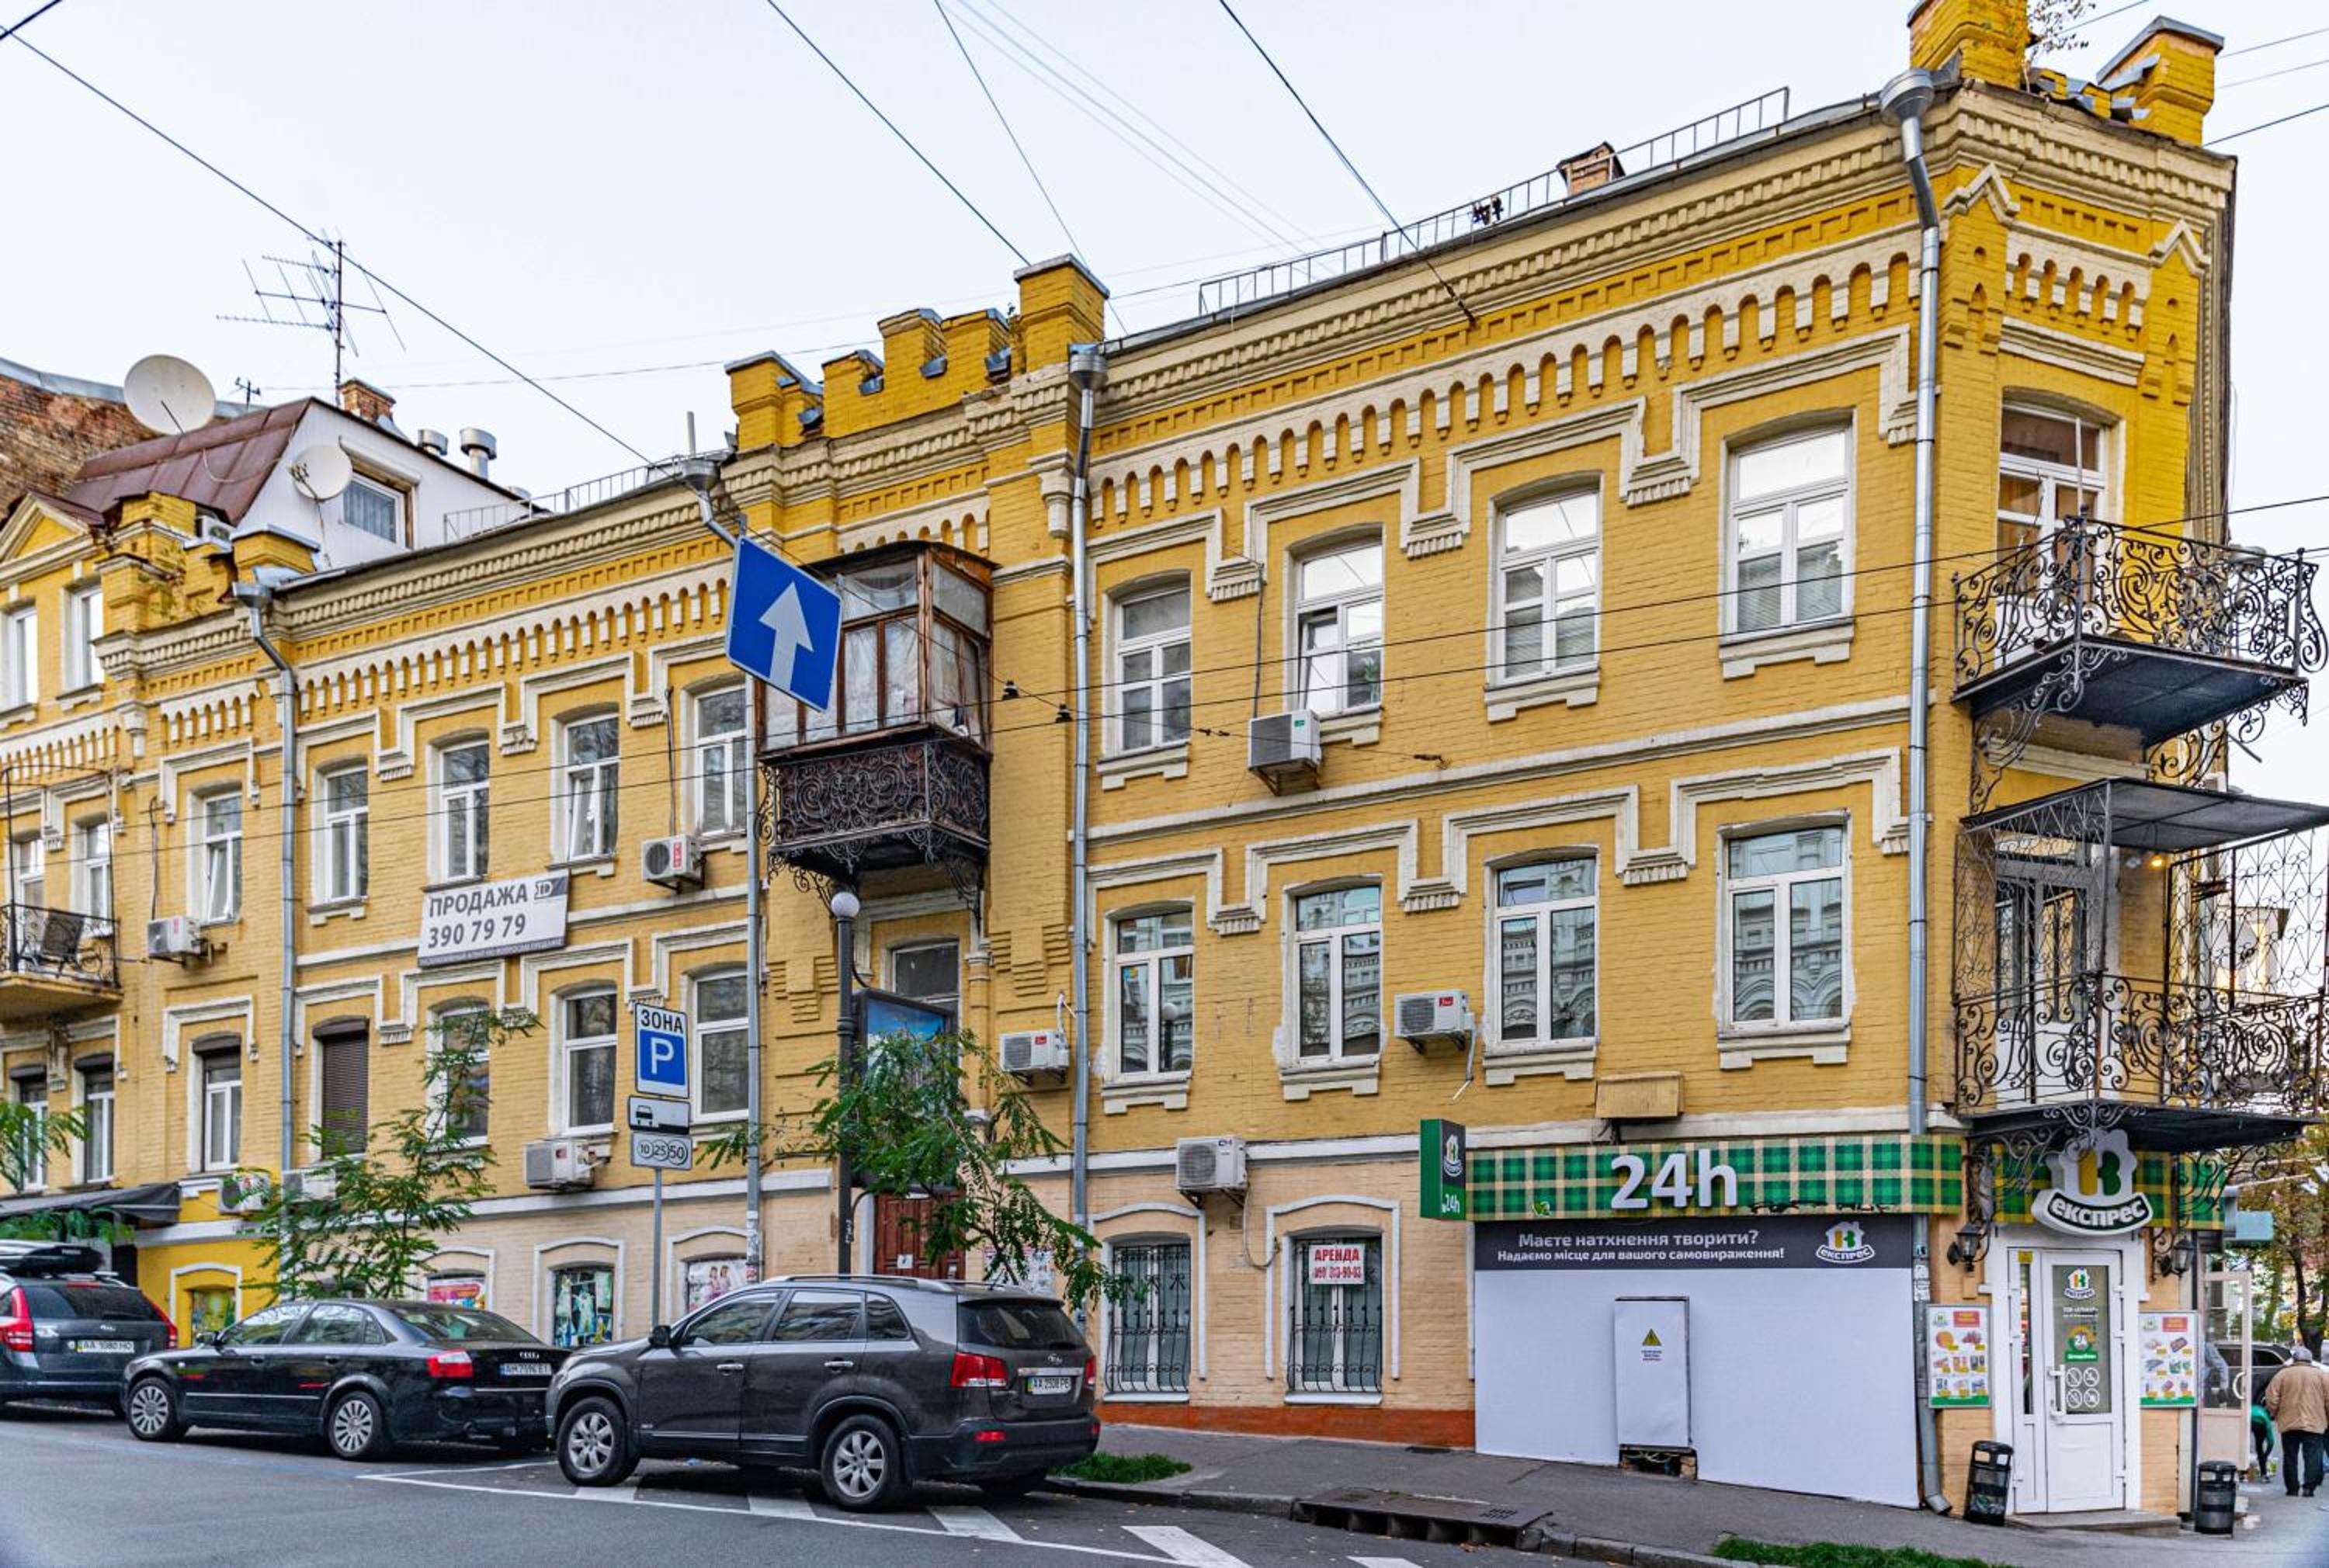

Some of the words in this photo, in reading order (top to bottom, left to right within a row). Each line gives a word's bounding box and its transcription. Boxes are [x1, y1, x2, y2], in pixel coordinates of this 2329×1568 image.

[429, 883, 528, 918] ПРОДАЖА
[428, 923, 464, 949] 390
[471, 918, 495, 942] 79
[502, 914, 526, 936] 79
[640, 1009, 684, 1034] ЗОНА
[651, 1037, 675, 1074] P
[1611, 1149, 1737, 1209] 24h
[1519, 1233, 1572, 1247] Маєте
[1575, 1234, 1668, 1247] натхнення
[1673, 1230, 1759, 1248] творити?
[1314, 1247, 1360, 1262] АРЕНДА
[1498, 1250, 1552, 1262] Надаємо
[1554, 1250, 1590, 1261] місце
[1591, 1251, 1616, 1261] для
[1618, 1250, 1667, 1261] вашого
[1669, 1247, 1785, 1262] самовираження!
